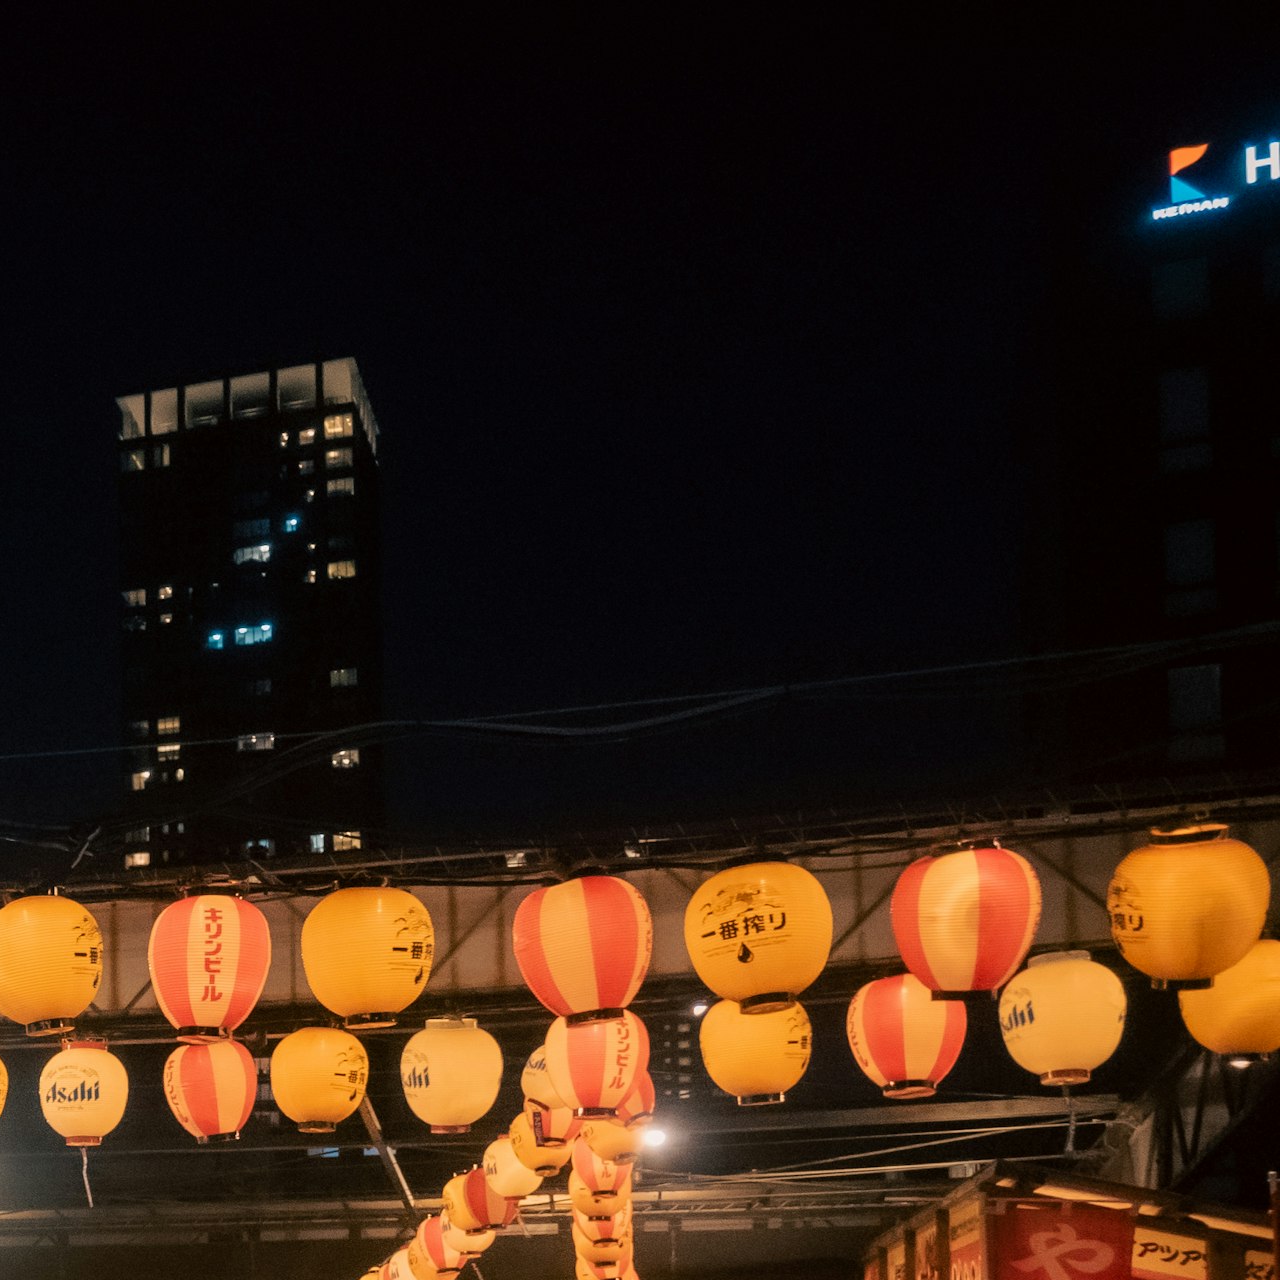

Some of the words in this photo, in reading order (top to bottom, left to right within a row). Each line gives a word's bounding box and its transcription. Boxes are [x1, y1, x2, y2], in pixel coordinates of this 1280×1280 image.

[701, 912, 787, 941] 一番搾り
[201, 907, 223, 1002] キリンビール
[46, 1080, 100, 1103] Asahi
